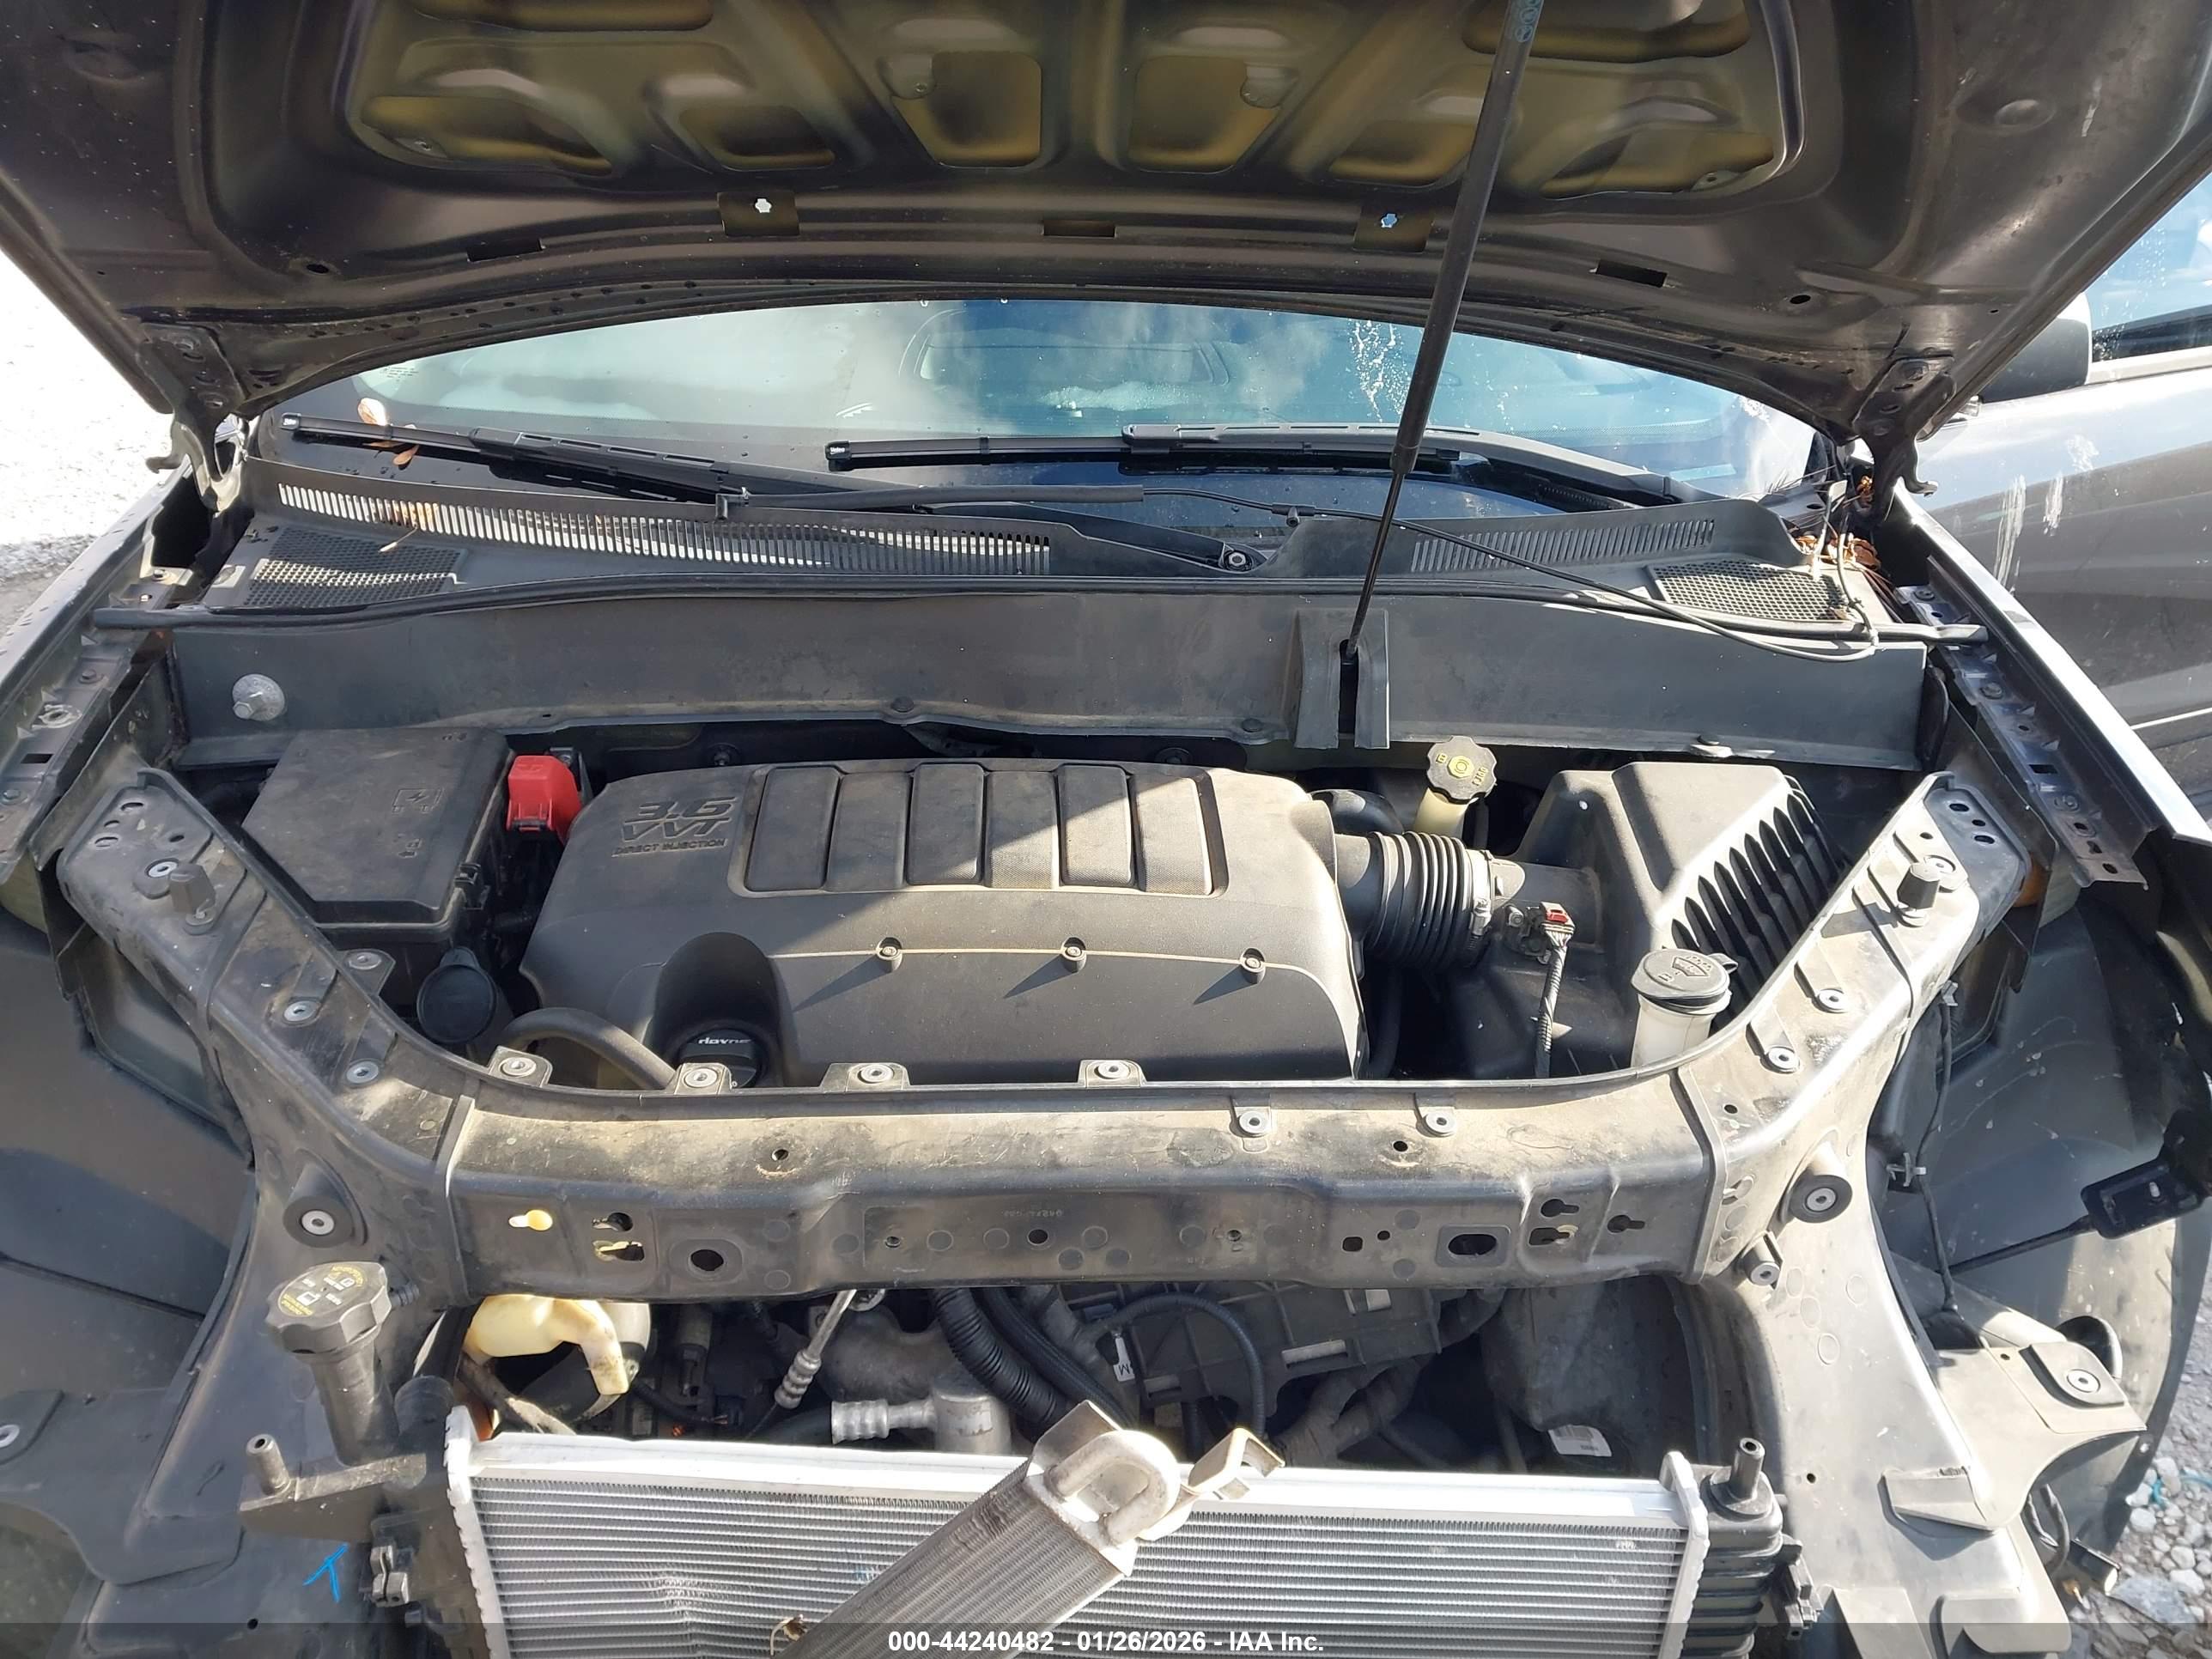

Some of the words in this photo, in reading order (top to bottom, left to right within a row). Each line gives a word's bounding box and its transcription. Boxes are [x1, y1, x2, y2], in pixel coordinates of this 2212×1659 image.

[638, 795, 738, 819] 3.6
[622, 817, 732, 842] VVT
[613, 843, 659, 856] DIRECT
[661, 838, 728, 852] INJECTION
